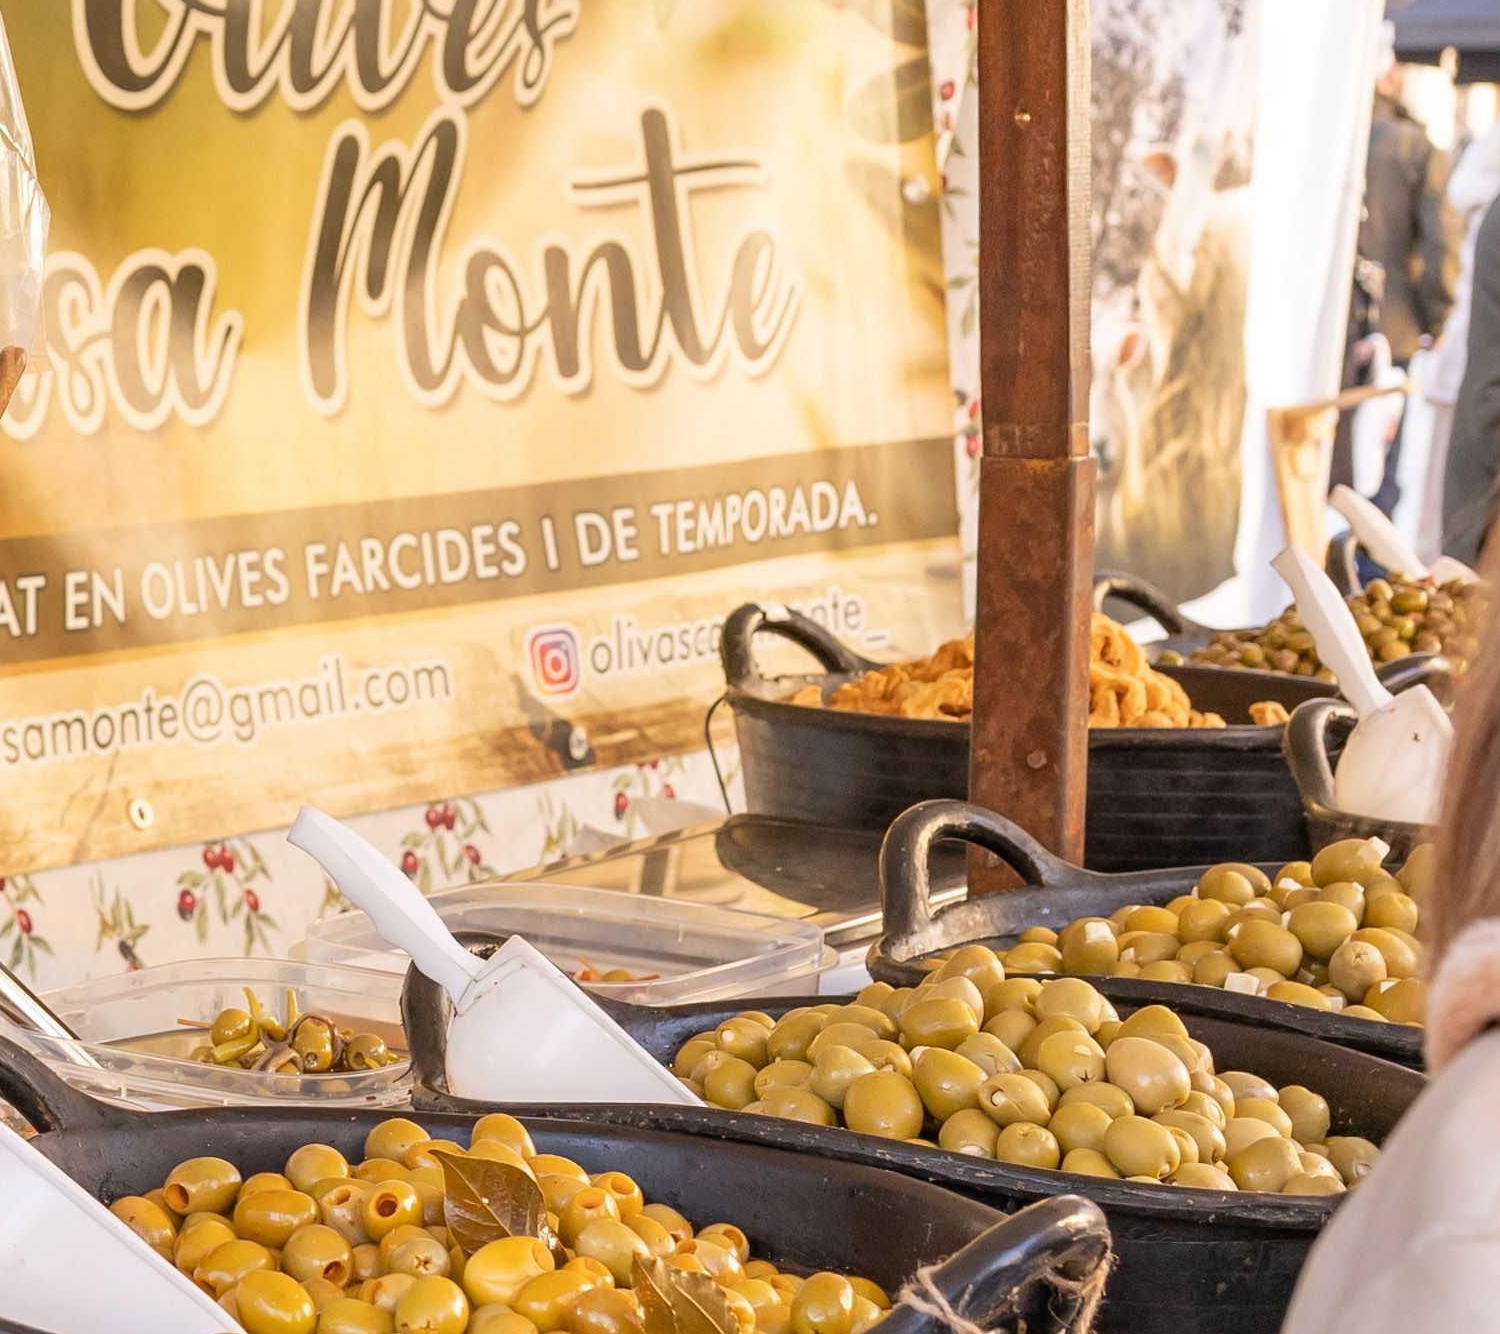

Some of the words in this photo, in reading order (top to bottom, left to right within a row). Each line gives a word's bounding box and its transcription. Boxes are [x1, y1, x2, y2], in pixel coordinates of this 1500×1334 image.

[2, 247, 245, 442] sa
[298, 102, 800, 412] Monte
[63, 569, 126, 630] EN
[141, 547, 290, 621] OLIVES
[304, 520, 527, 600] FARCIDES
[542, 516, 559, 571] I
[575, 507, 640, 567] DE
[650, 479, 880, 557] TEMPORADA.
